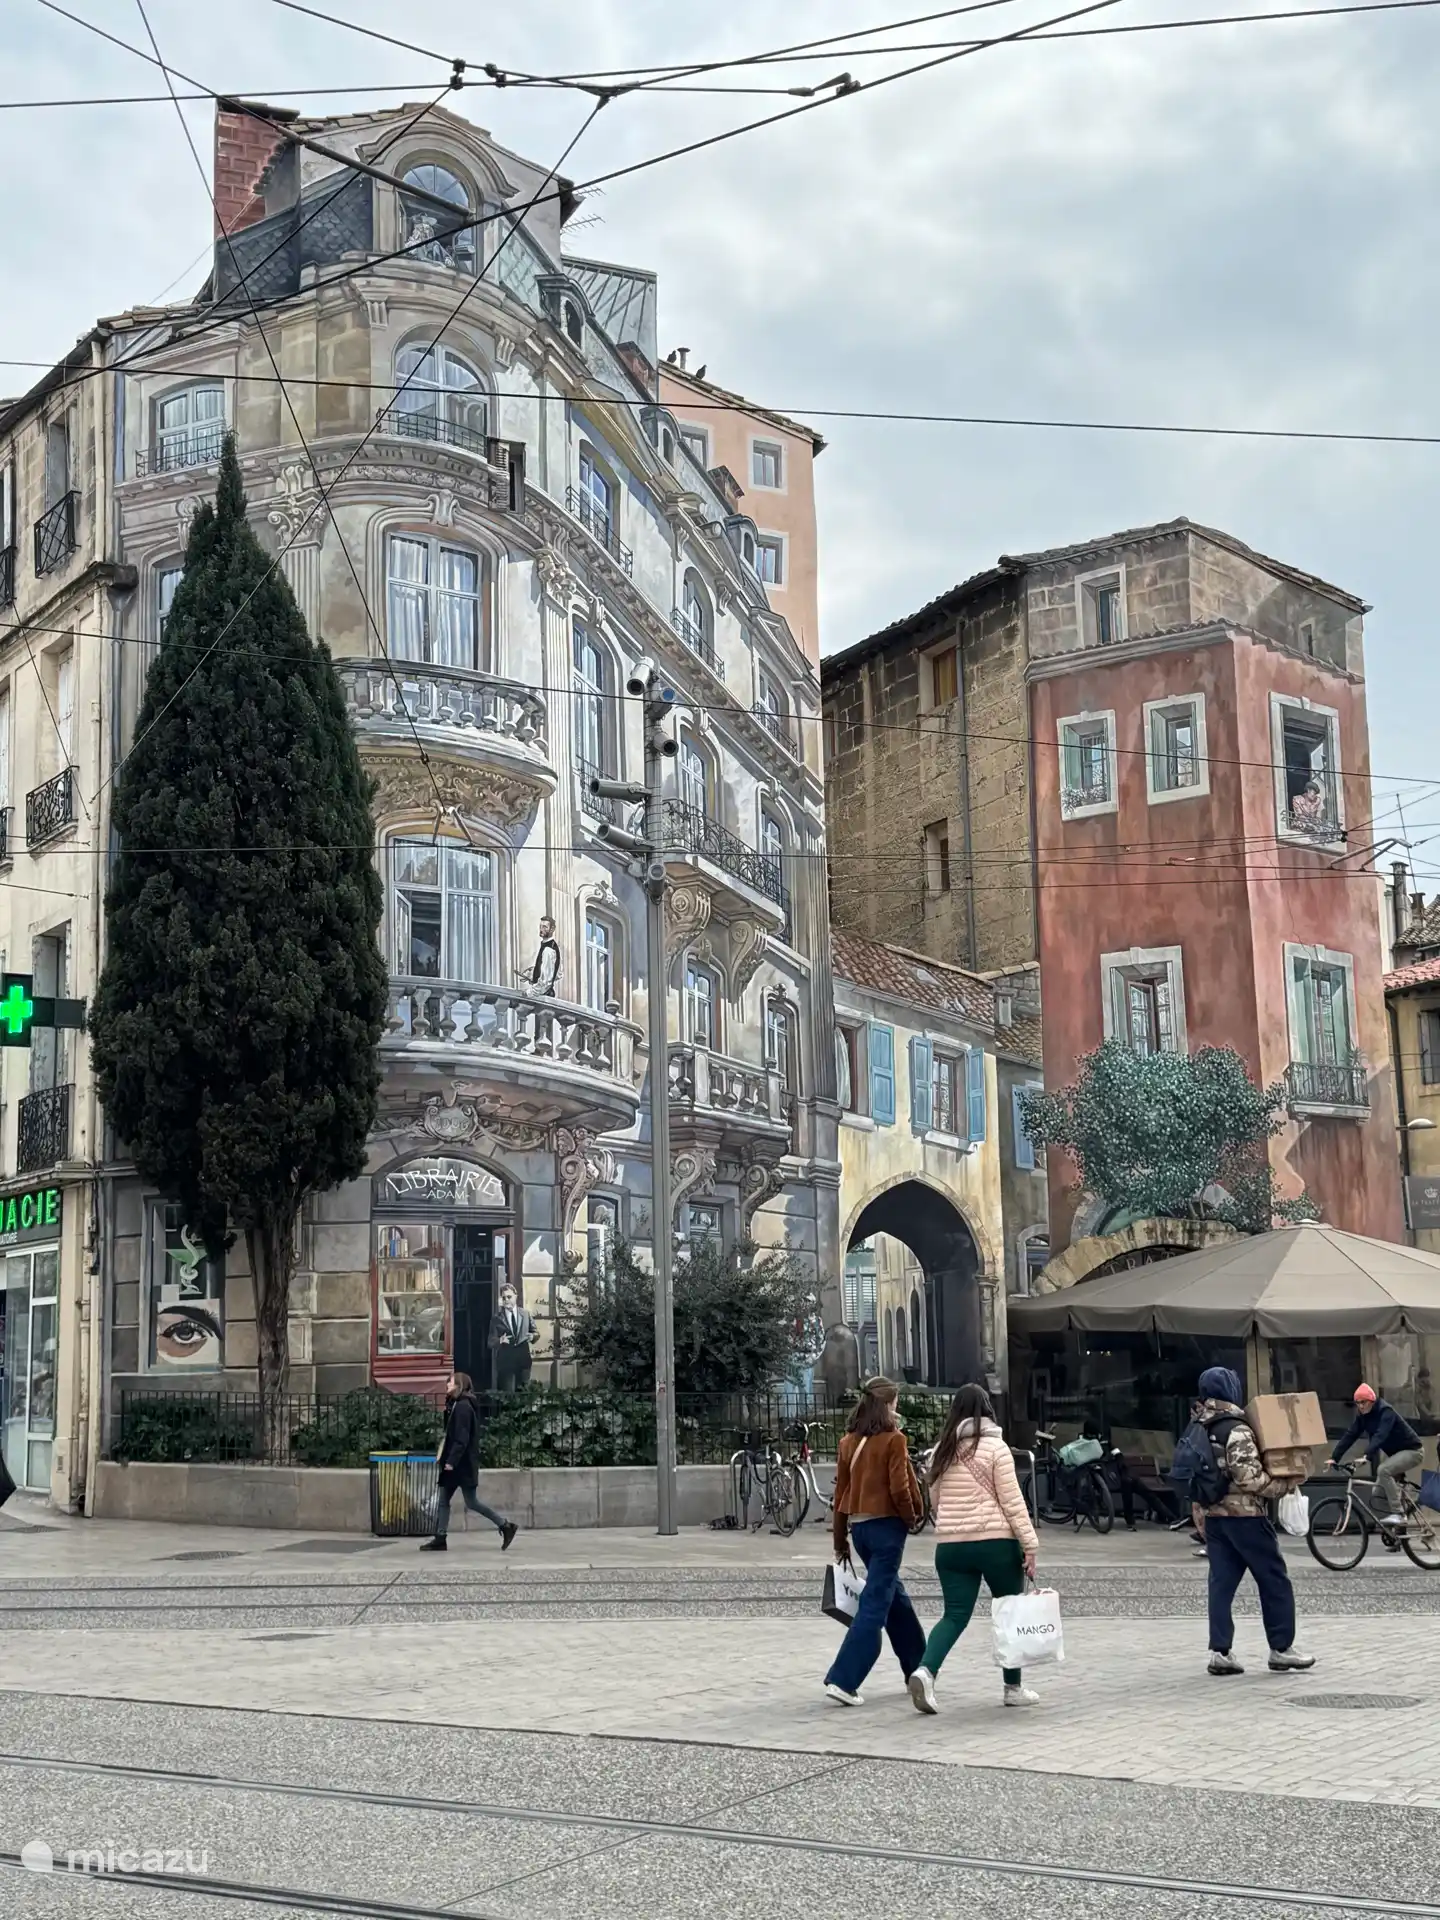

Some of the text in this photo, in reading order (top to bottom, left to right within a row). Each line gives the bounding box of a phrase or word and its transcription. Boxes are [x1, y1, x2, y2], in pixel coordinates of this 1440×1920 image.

[386, 1168, 502, 1196] LIBRAIRIE
[0, 1189, 58, 1233] ACIE
[1016, 1623, 1055, 1636] MANGO
